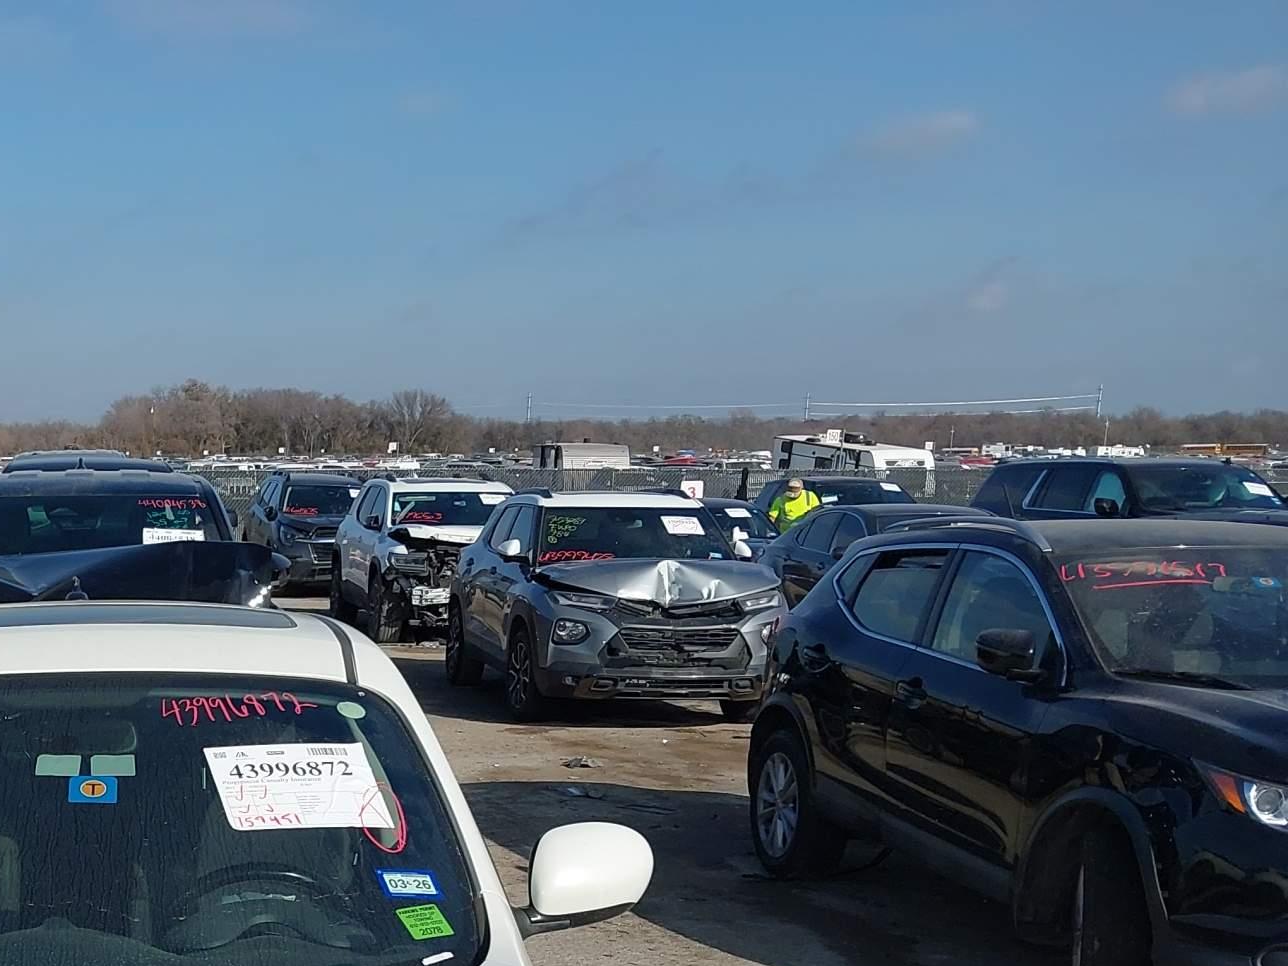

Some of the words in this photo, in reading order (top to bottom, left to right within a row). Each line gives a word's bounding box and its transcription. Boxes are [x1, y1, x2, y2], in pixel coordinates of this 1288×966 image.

[687, 486, 696, 498] 3
[162, 691, 318, 727] 43996872
[229, 760, 353, 779] 43996872
[419, 925, 444, 936] 2078
